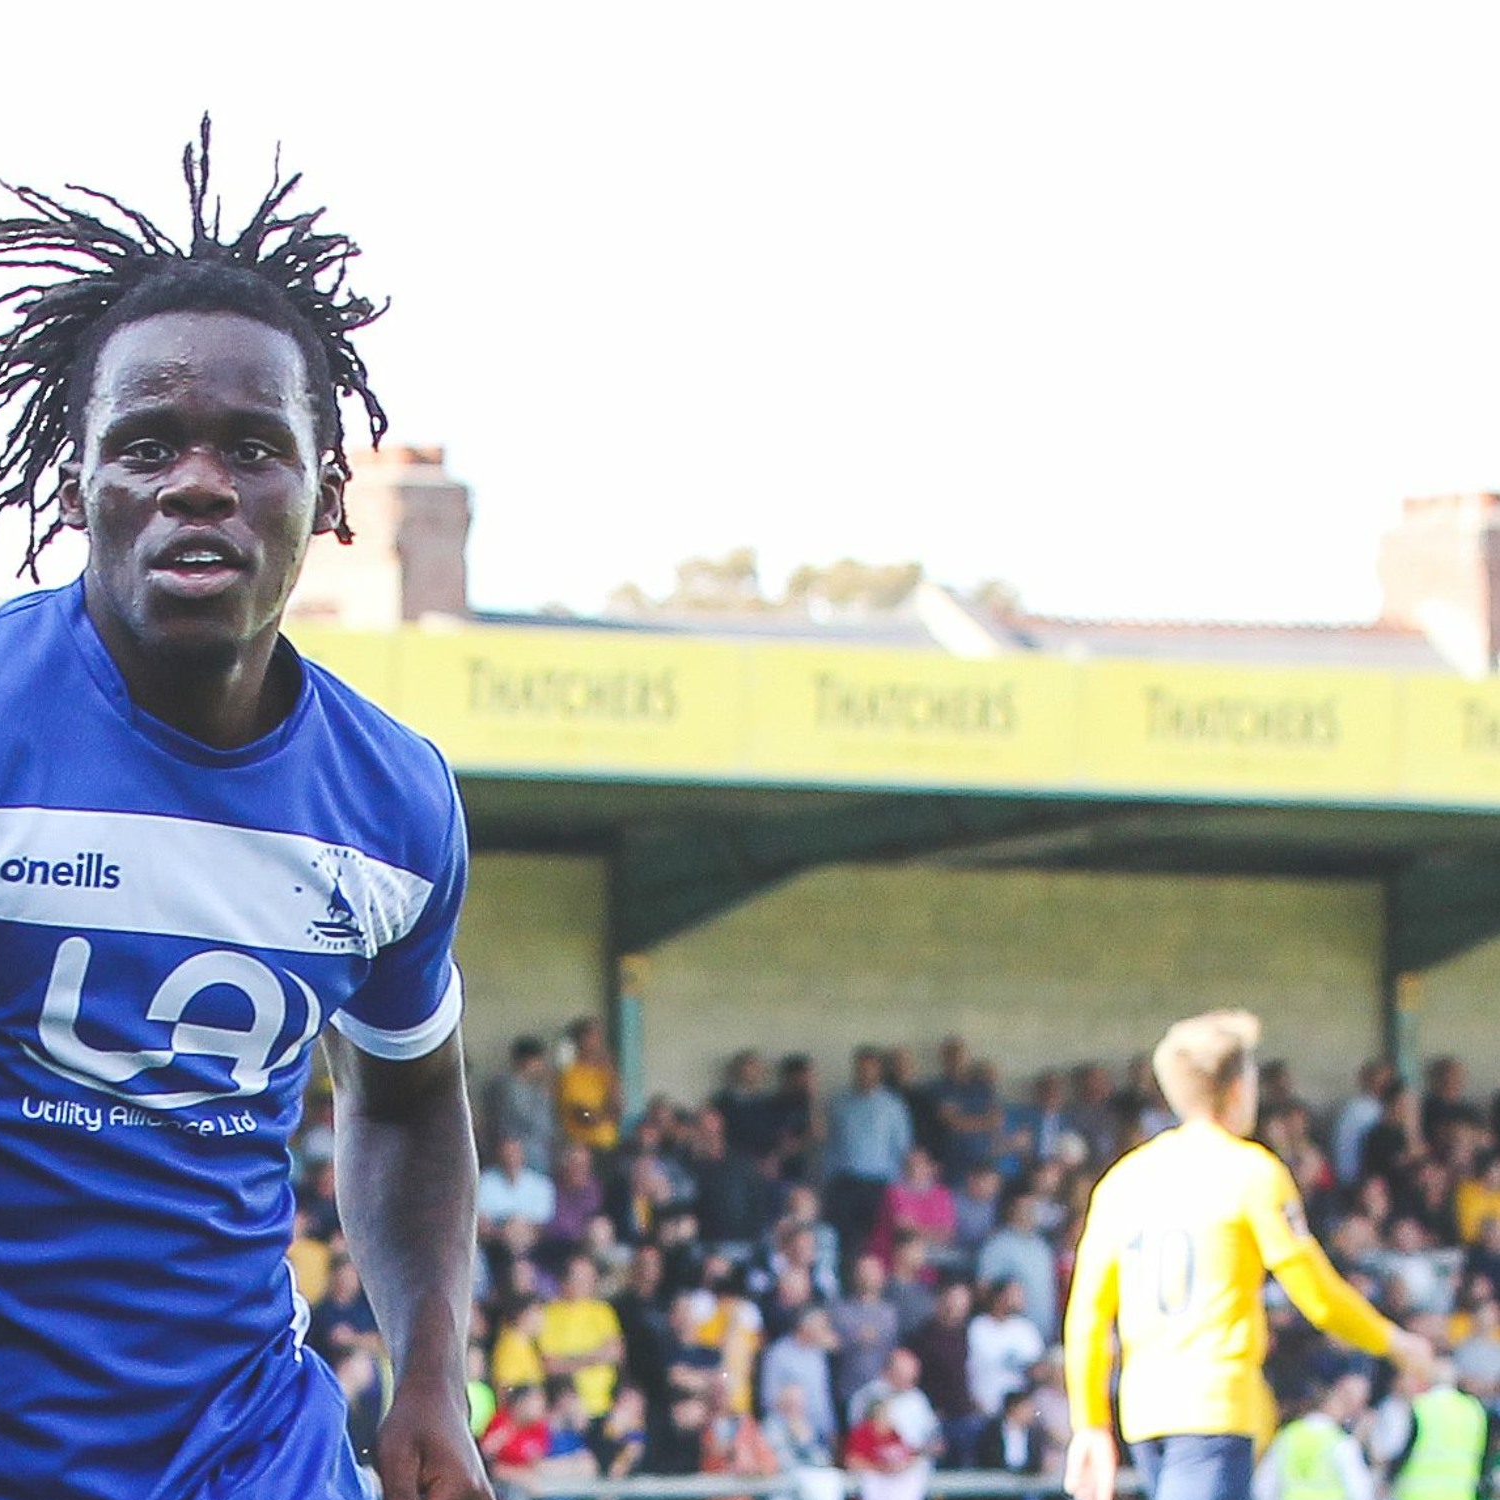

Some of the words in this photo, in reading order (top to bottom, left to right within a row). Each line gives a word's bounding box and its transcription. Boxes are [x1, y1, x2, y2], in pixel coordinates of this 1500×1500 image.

[464, 656, 680, 722] THATCHERS
[812, 670, 1017, 734] THATCHERS
[22, 1096, 102, 1131] Utility
[218, 1110, 258, 1136] Ltd
